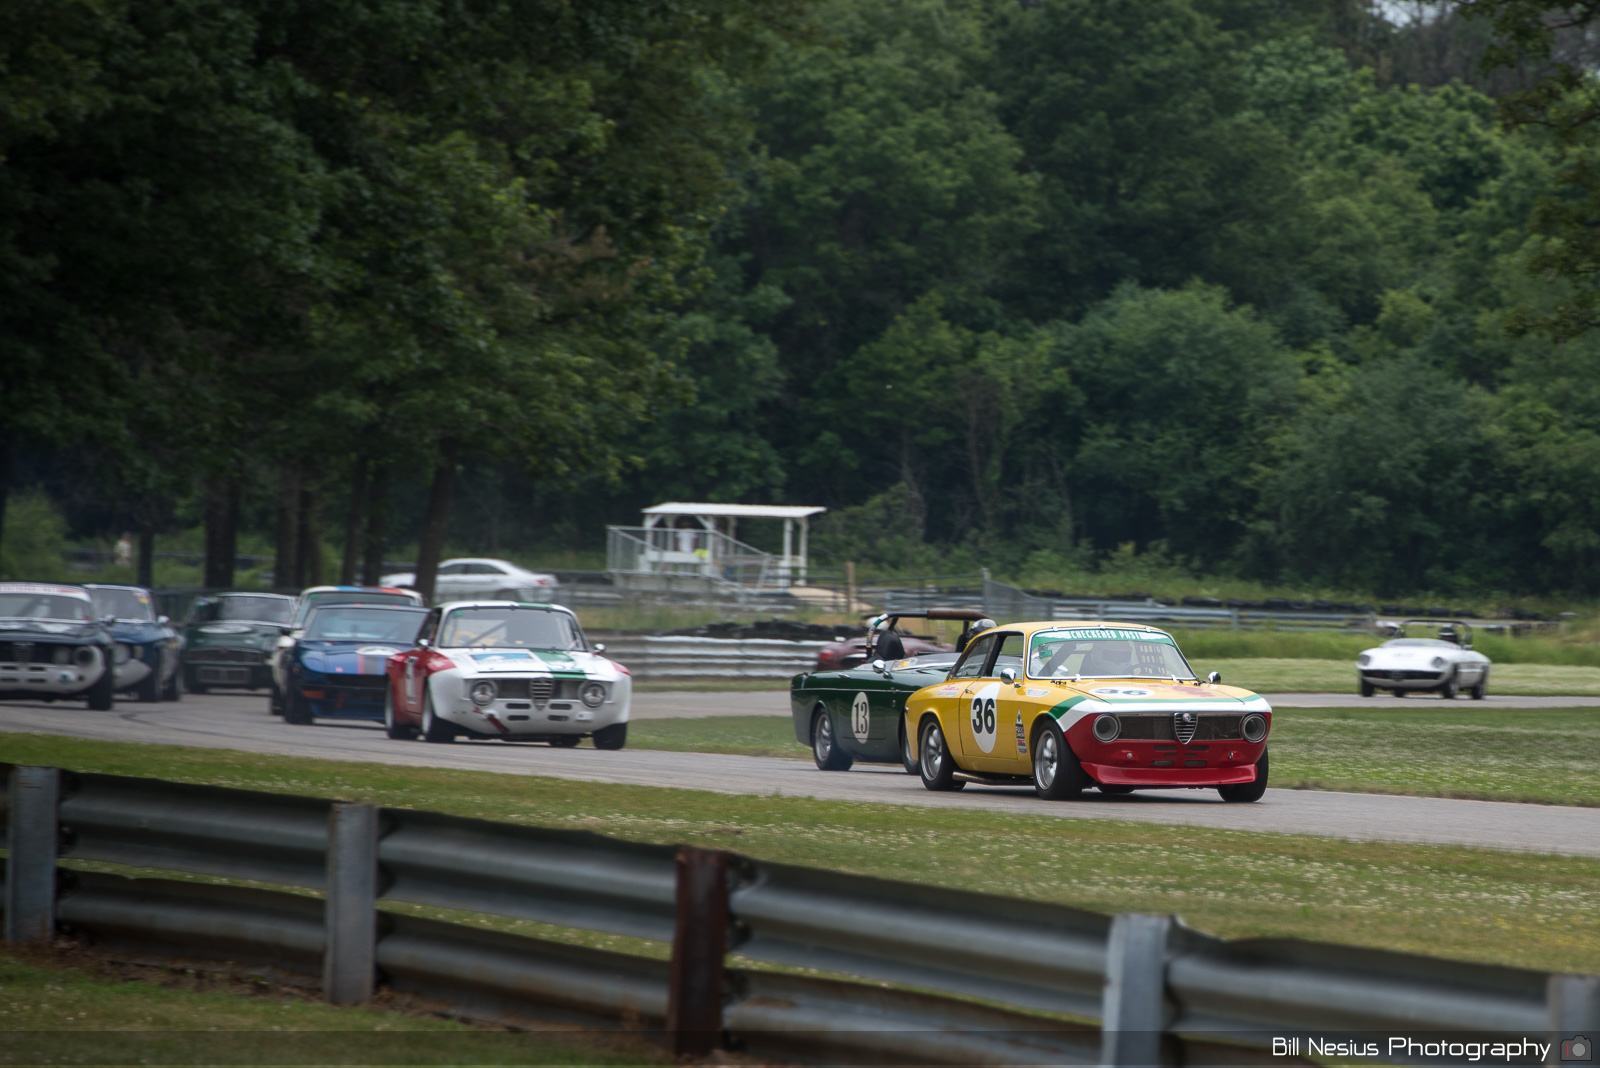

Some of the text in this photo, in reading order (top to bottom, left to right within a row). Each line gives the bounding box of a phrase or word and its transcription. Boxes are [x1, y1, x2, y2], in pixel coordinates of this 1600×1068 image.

[1070, 629, 1141, 640] CHECKERED PAST
[1095, 688, 1147, 696] 36
[854, 701, 868, 735] 13
[972, 698, 995, 735] 36
